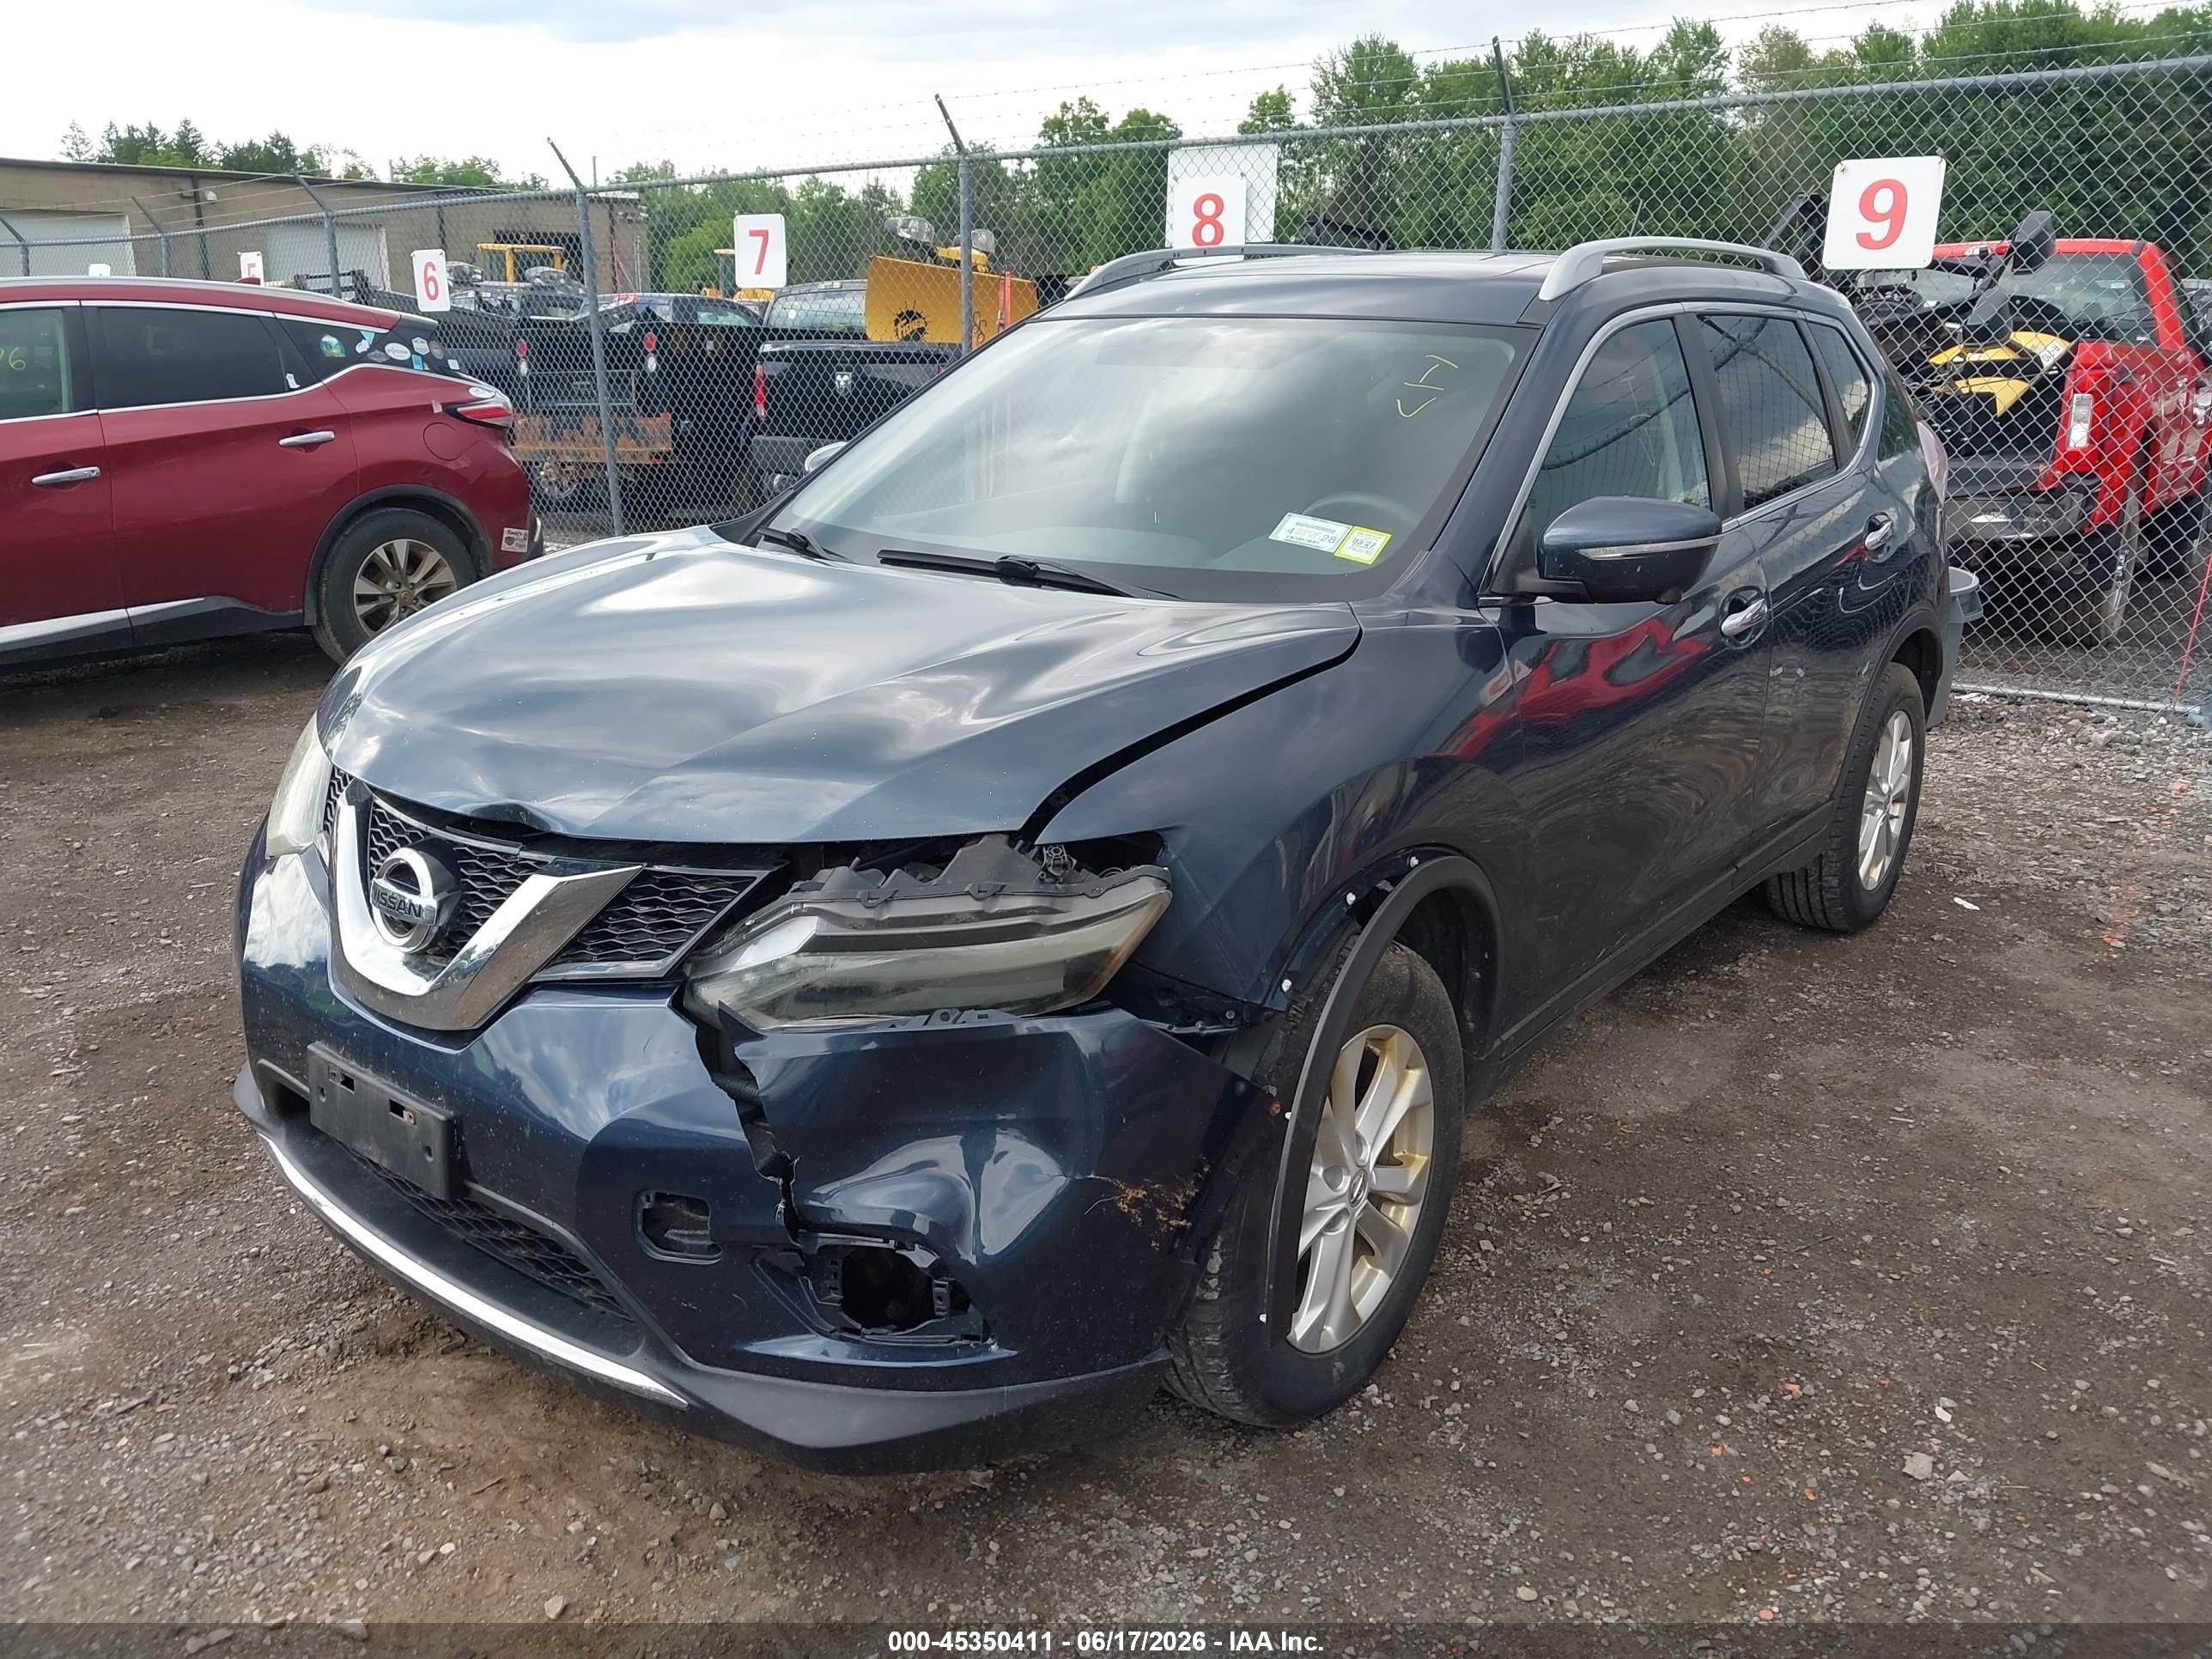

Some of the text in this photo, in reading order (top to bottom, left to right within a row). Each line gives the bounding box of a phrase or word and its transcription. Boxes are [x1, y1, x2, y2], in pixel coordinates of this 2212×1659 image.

[1192, 192, 1224, 246] 8
[1856, 179, 1908, 250] 9
[749, 229, 769, 275] 7
[423, 261, 440, 301] 6
[373, 884, 422, 918] NISSAN
